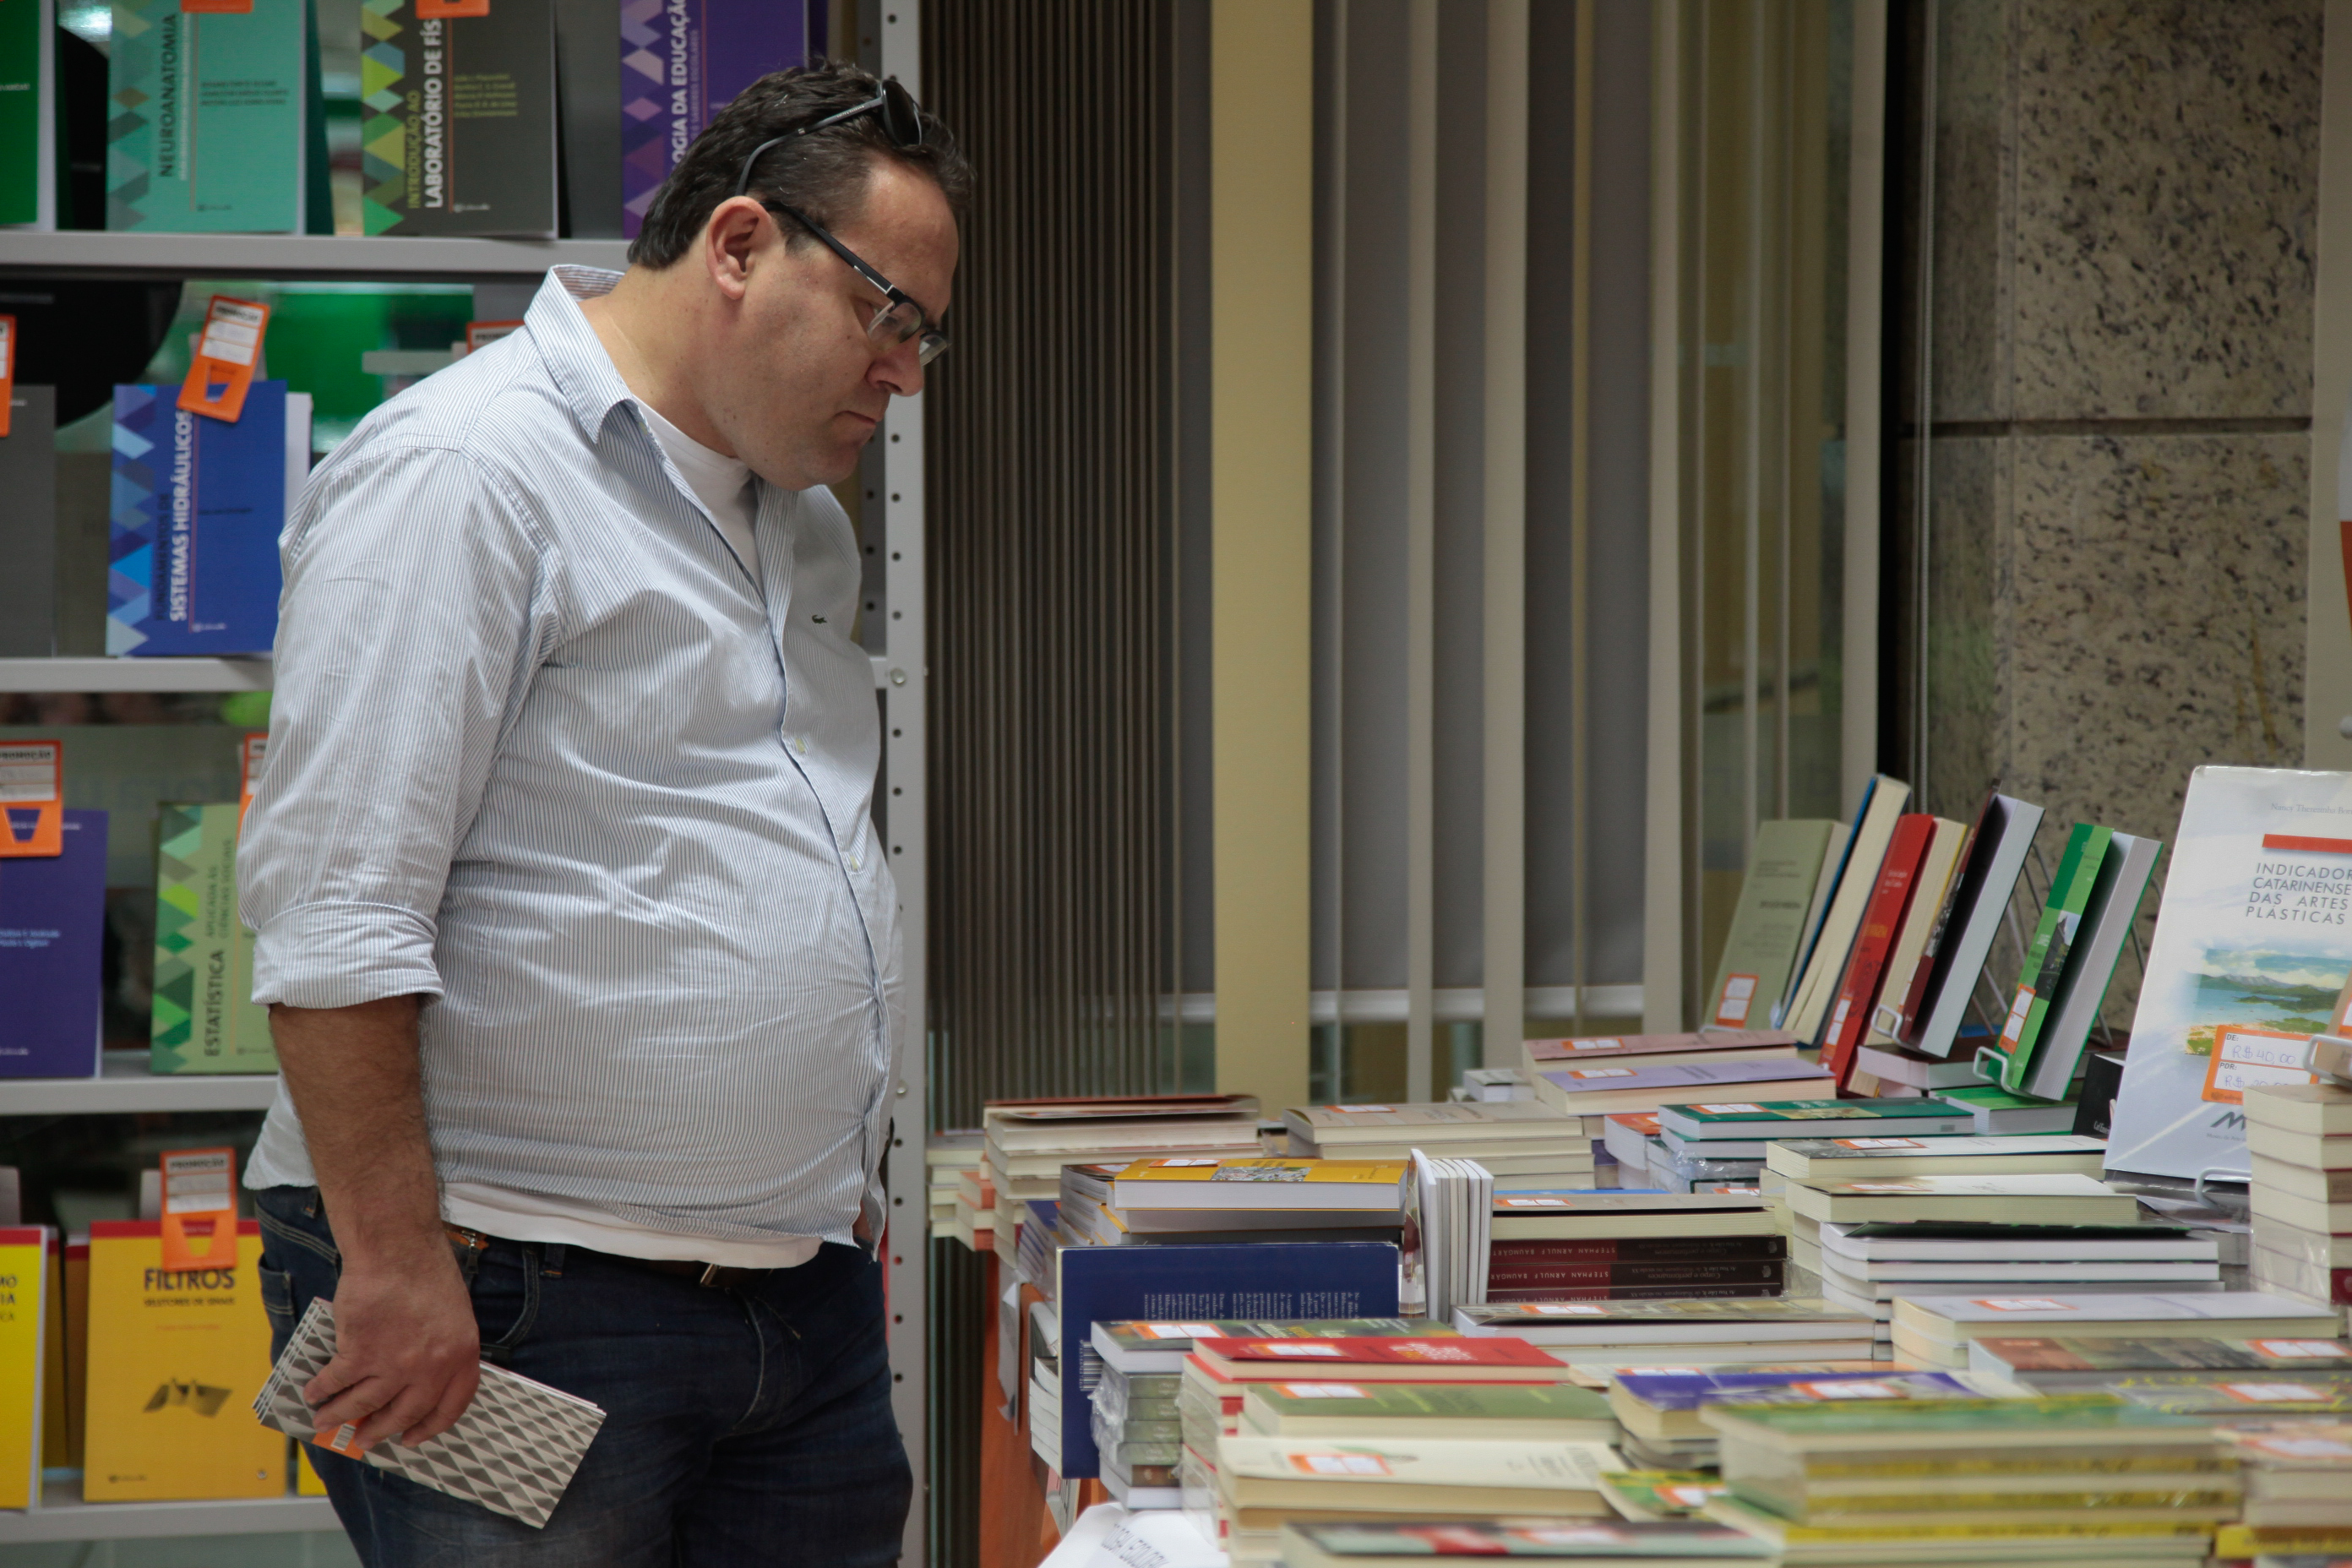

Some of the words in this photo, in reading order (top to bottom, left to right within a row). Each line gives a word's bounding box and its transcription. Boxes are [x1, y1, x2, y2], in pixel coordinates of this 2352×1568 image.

[424, 50, 443, 74] DE
[158, 14, 177, 177] NEUROANATOMIA
[406, 90, 421, 112] AO
[672, 90, 688, 115] DA
[420, 78, 443, 208] LABORATÓRIO
[406, 115, 422, 209] INTRODUÇÃO
[171, 411, 193, 531] HIDRÁULICOS
[158, 493, 170, 509] DE
[155, 515, 169, 621] FUNDAMENTOS
[170, 533, 189, 622] SISTEMAS
[0, 750, 51, 760] ROMOÇÃO
[2271, 803, 2294, 813] Nancy
[2296, 804, 2336, 814] Therezinha
[2253, 877, 2352, 896] CATARINENSE
[2250, 891, 2283, 905] DAS
[2297, 896, 2349, 910] ARTES
[2246, 905, 2345, 925] PLÁSTICAS
[203, 950, 226, 1057] ESTATÍSTICA
[2233, 1045, 2253, 1059] R$
[2257, 1050, 2295, 1064] 40,00
[2225, 1075, 2245, 1088] R$
[144, 1268, 236, 1291] FILTROS
